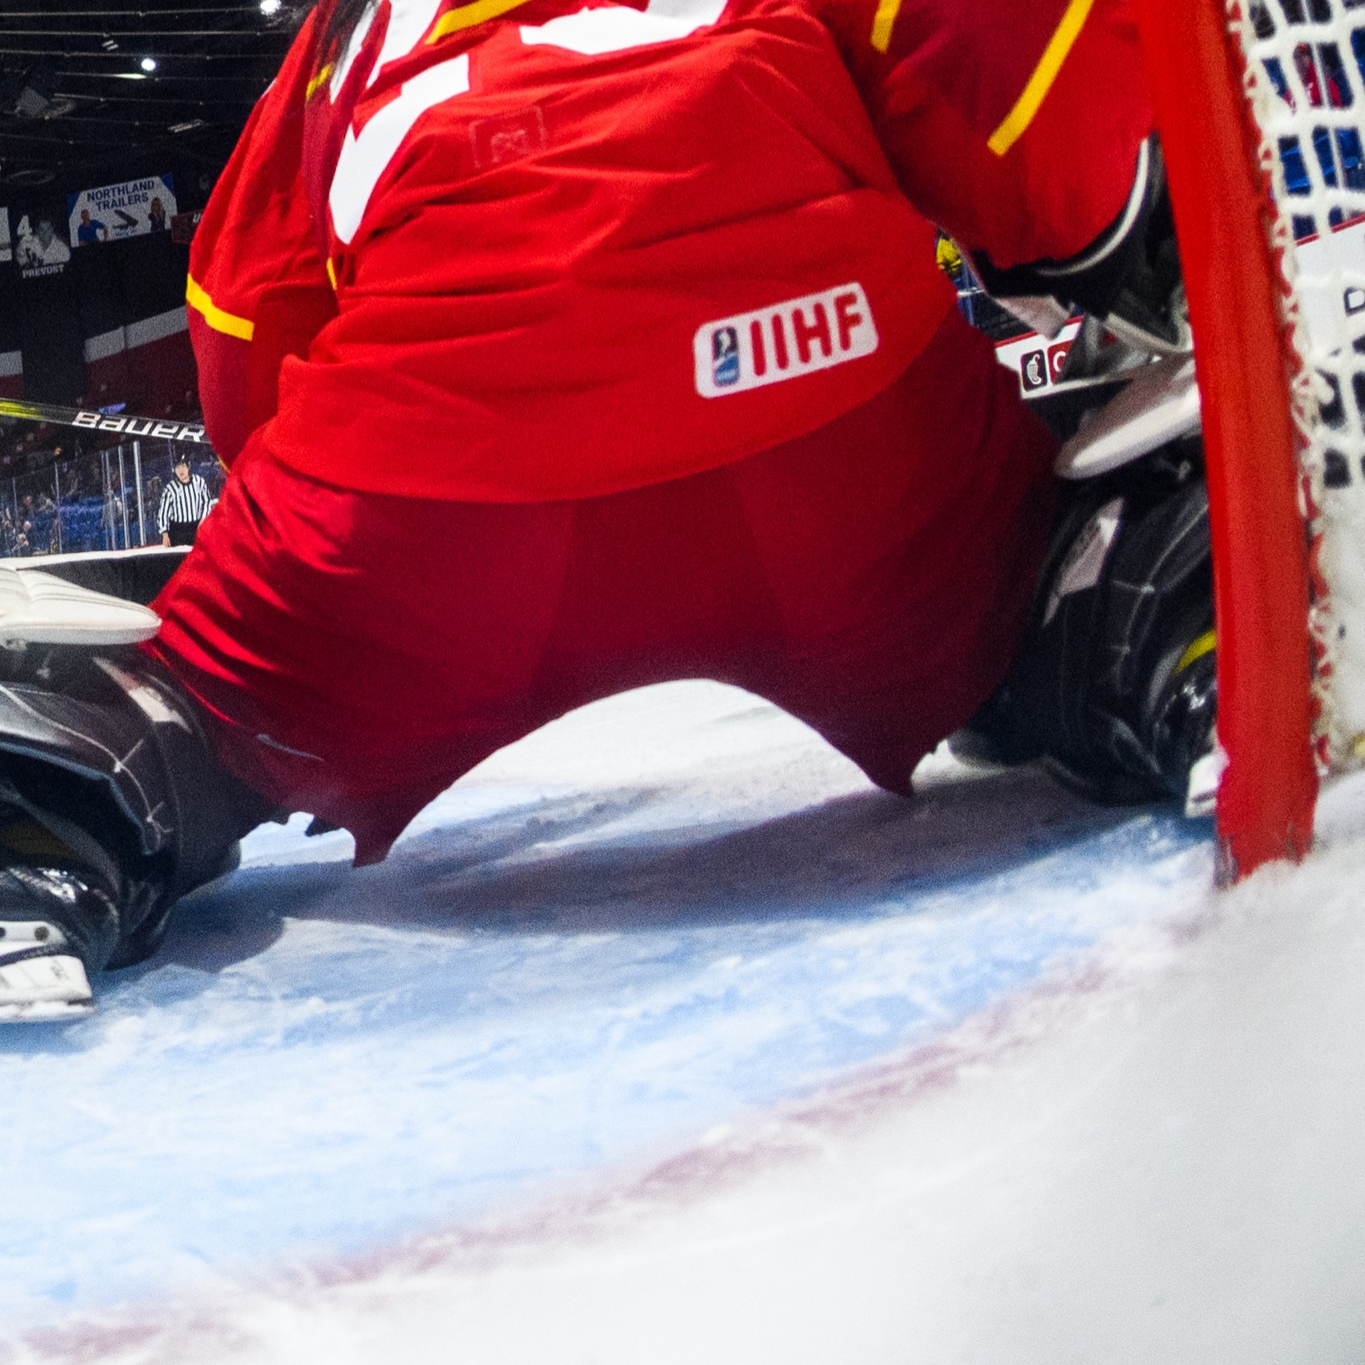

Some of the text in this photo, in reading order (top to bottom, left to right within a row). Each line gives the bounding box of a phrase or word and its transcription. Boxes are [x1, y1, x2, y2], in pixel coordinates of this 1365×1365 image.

[86, 179, 155, 203] NORTHLAND
[95, 192, 150, 212] TRAILERS
[22, 264, 66, 279] PREVOST
[748, 291, 864, 377] IIHF
